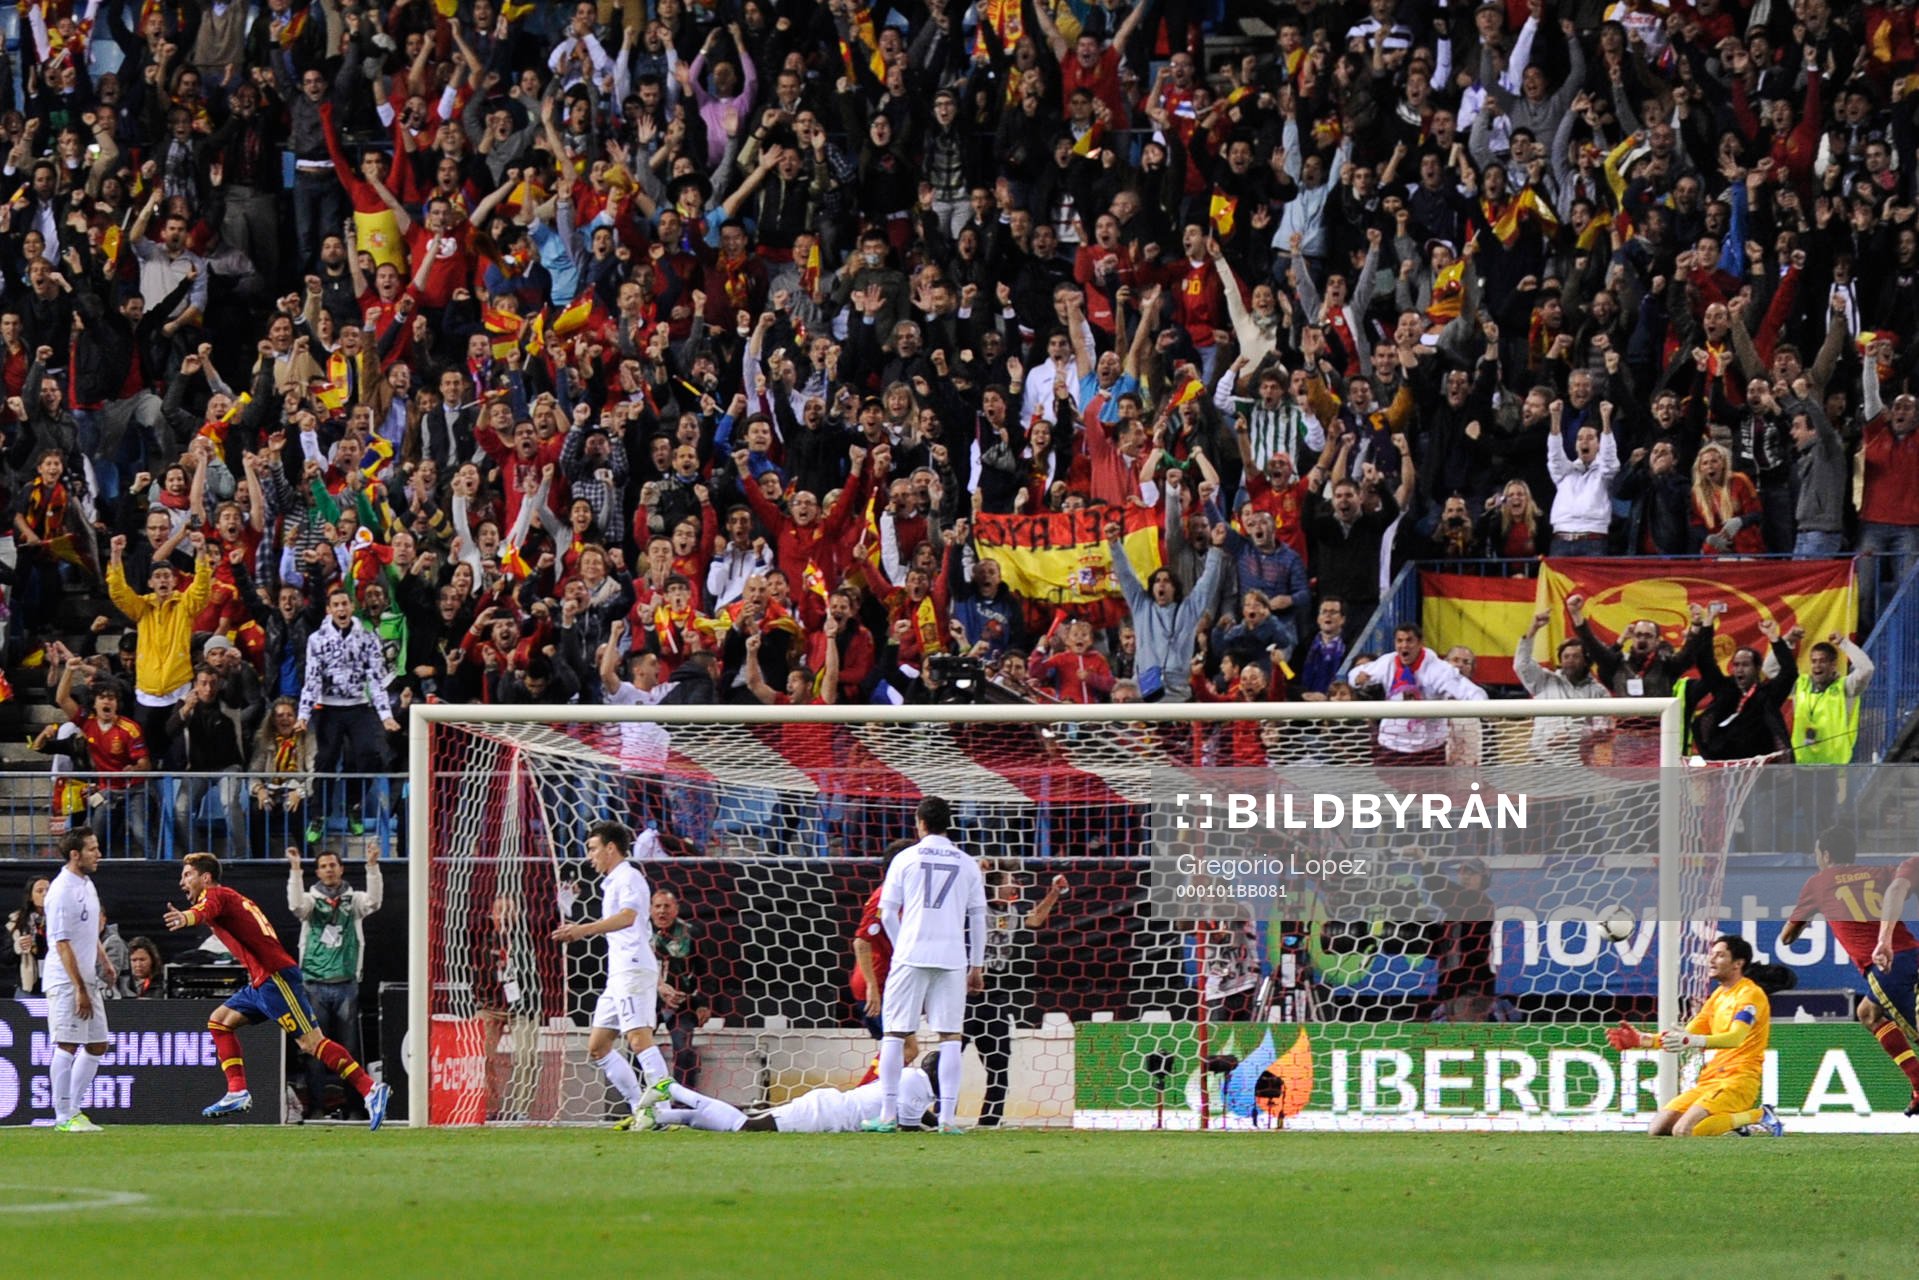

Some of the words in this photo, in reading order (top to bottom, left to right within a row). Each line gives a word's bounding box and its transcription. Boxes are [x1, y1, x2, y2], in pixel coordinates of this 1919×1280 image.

[920, 862, 960, 909] 17
[1834, 880, 1884, 922] 16
[1331, 1049, 1873, 1116] IBERDRLA
